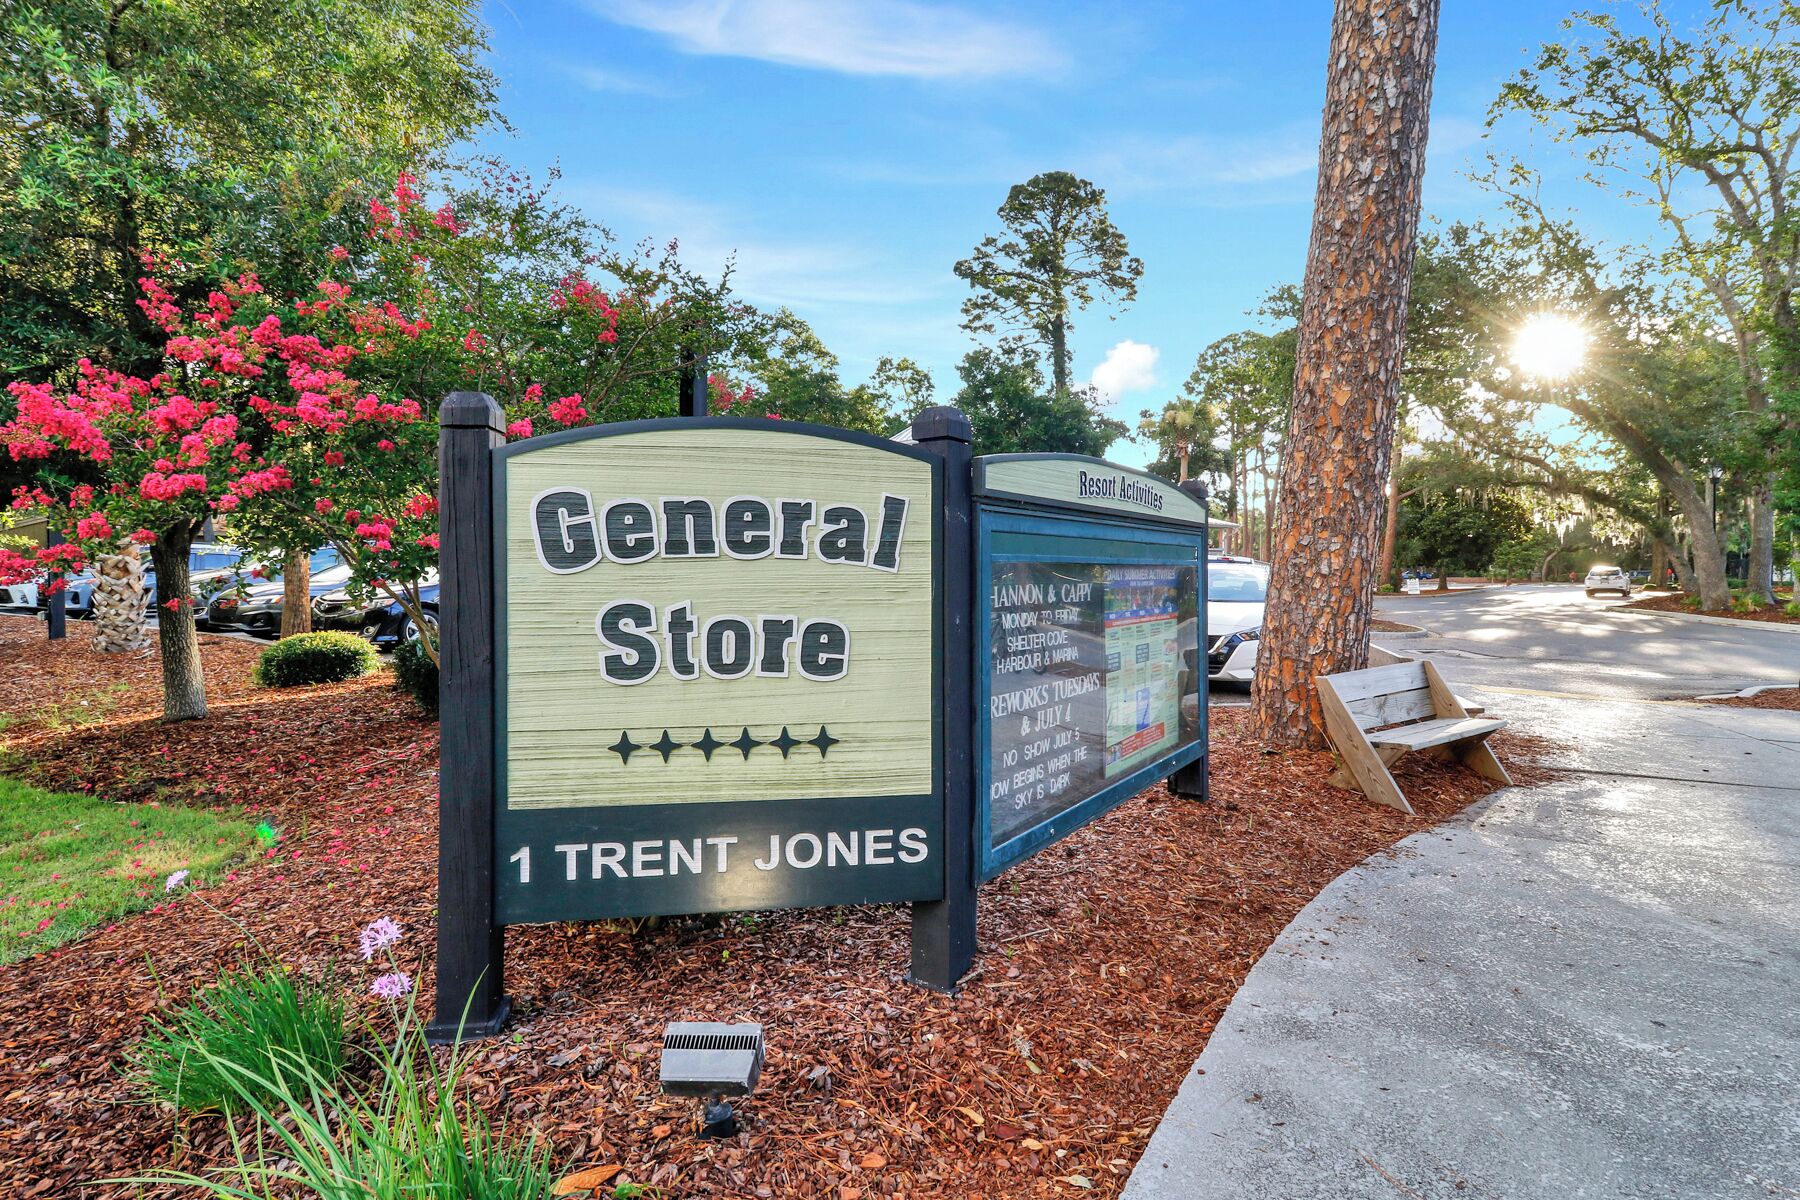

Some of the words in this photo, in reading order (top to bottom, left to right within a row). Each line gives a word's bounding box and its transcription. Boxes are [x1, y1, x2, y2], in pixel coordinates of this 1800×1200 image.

[1079, 470, 1116, 498] Resort
[1119, 475, 1163, 511] Activities
[530, 486, 910, 575] General
[1047, 584, 1056, 604] &
[1061, 583, 1093, 603] CAPPY
[1001, 612, 1039, 630] MONDAY
[1041, 610, 1052, 625] TO
[1055, 608, 1080, 622] FRIDAY
[595, 598, 851, 687] Store
[996, 652, 1042, 675] HARBOUR
[1044, 651, 1050, 666] &
[1052, 646, 1079, 664] MARINA
[1007, 633, 1046, 653] SHELTER
[1047, 630, 1069, 647] COVE
[990, 684, 1049, 719] REWORKS
[1052, 672, 1100, 701] TUESDAYS
[1020, 715, 1031, 737] &
[1035, 704, 1063, 732] JULY
[1065, 702, 1071, 722] 4
[1003, 749, 1018, 769] NO
[1024, 738, 1051, 761] SHOW
[1053, 729, 1072, 750] JULY
[1074, 727, 1080, 741] 5
[1013, 763, 1044, 789] BEGINS
[1047, 752, 1071, 774] WHEN
[1074, 746, 1088, 764] THE
[1015, 788, 1033, 810] SKY
[1036, 784, 1045, 800] IS
[1050, 771, 1071, 794] DARK
[509, 846, 530, 883] 1
[554, 836, 739, 881] TRENT
[754, 827, 929, 871] JONES
